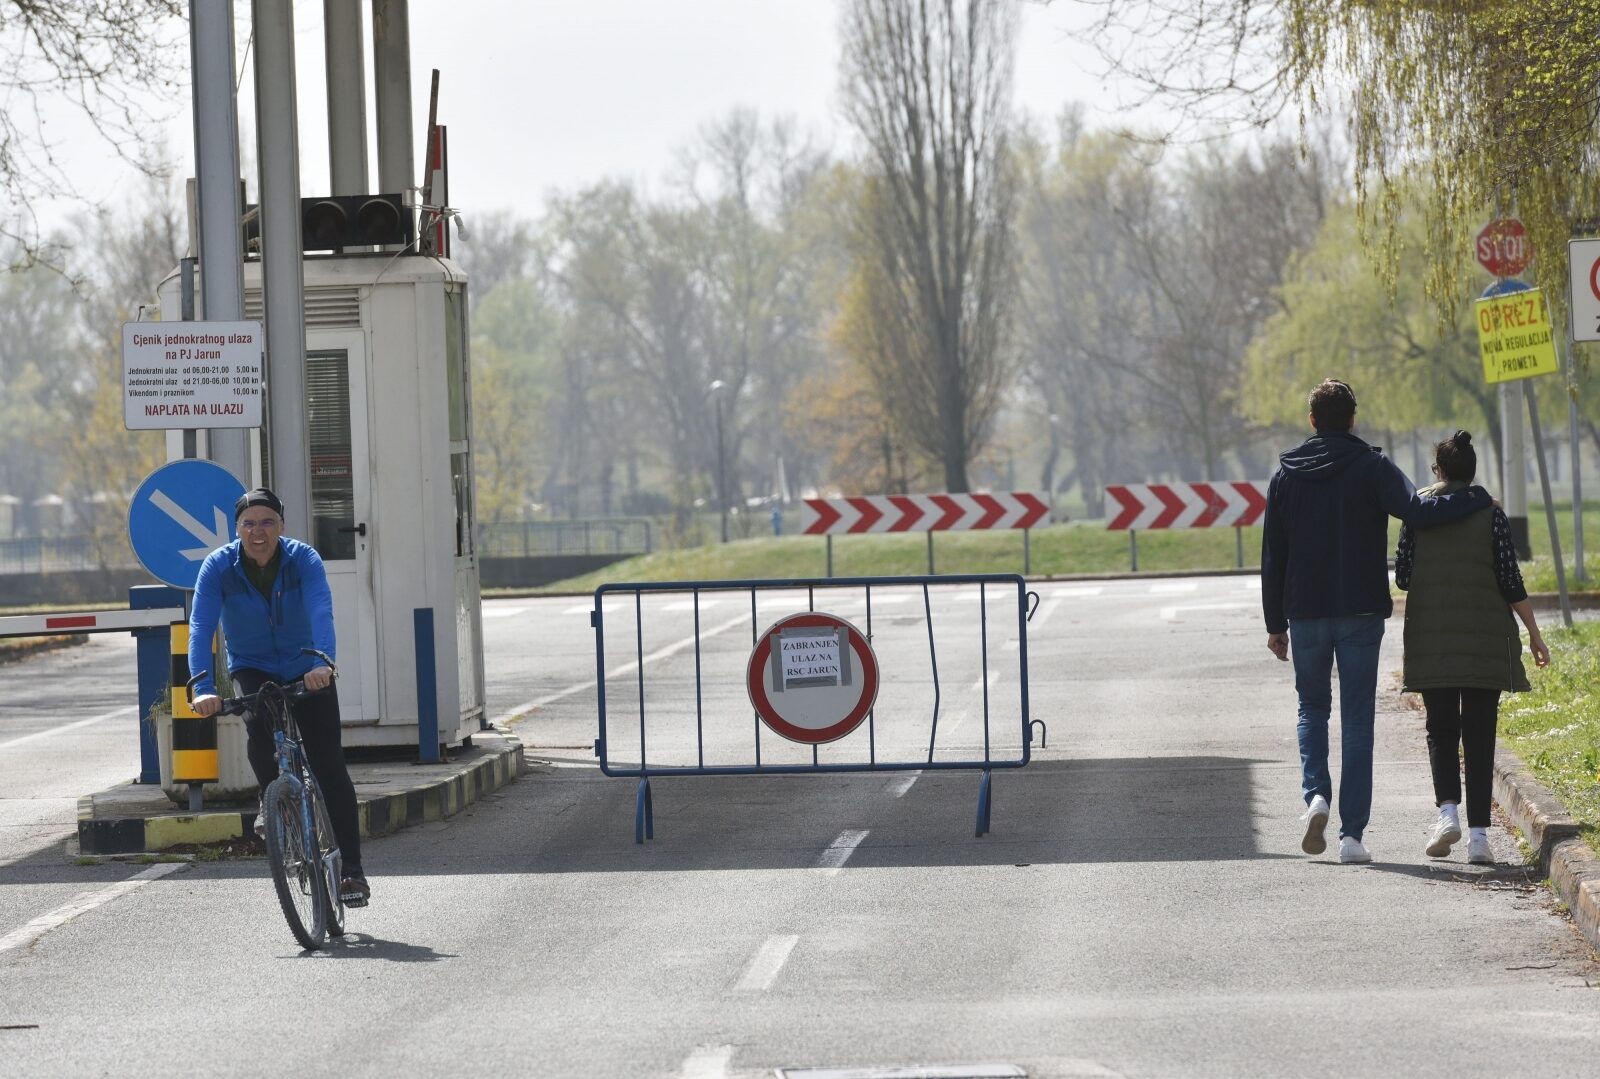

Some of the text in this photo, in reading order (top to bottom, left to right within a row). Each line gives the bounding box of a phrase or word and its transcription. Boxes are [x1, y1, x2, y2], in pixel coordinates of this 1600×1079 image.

[133, 333, 252, 348] Cjenik jednokratnog ulaza
[1483, 330, 1550, 354] NOVA REGULACIJA
[165, 349, 221, 360] na PJ Jarun
[1503, 354, 1538, 373] PROMETA
[128, 367, 163, 375] Jednokratni
[165, 366, 178, 375] ulaz
[182, 366, 191, 374] od
[236, 366, 250, 374] 5,00
[128, 378, 163, 386] Jednokratni
[165, 378, 178, 386] ulaz
[233, 377, 250, 386] 10,00
[128, 389, 159, 397] Vikendom
[163, 389, 195, 398] praznikom
[233, 388, 250, 397] 10,00
[145, 403, 244, 416] NAPLATA NA ULAZU
[783, 640, 839, 651] ZABRANJEN
[792, 653, 832, 663] ULAZ NA
[787, 665, 838, 676] RSC JARUN
